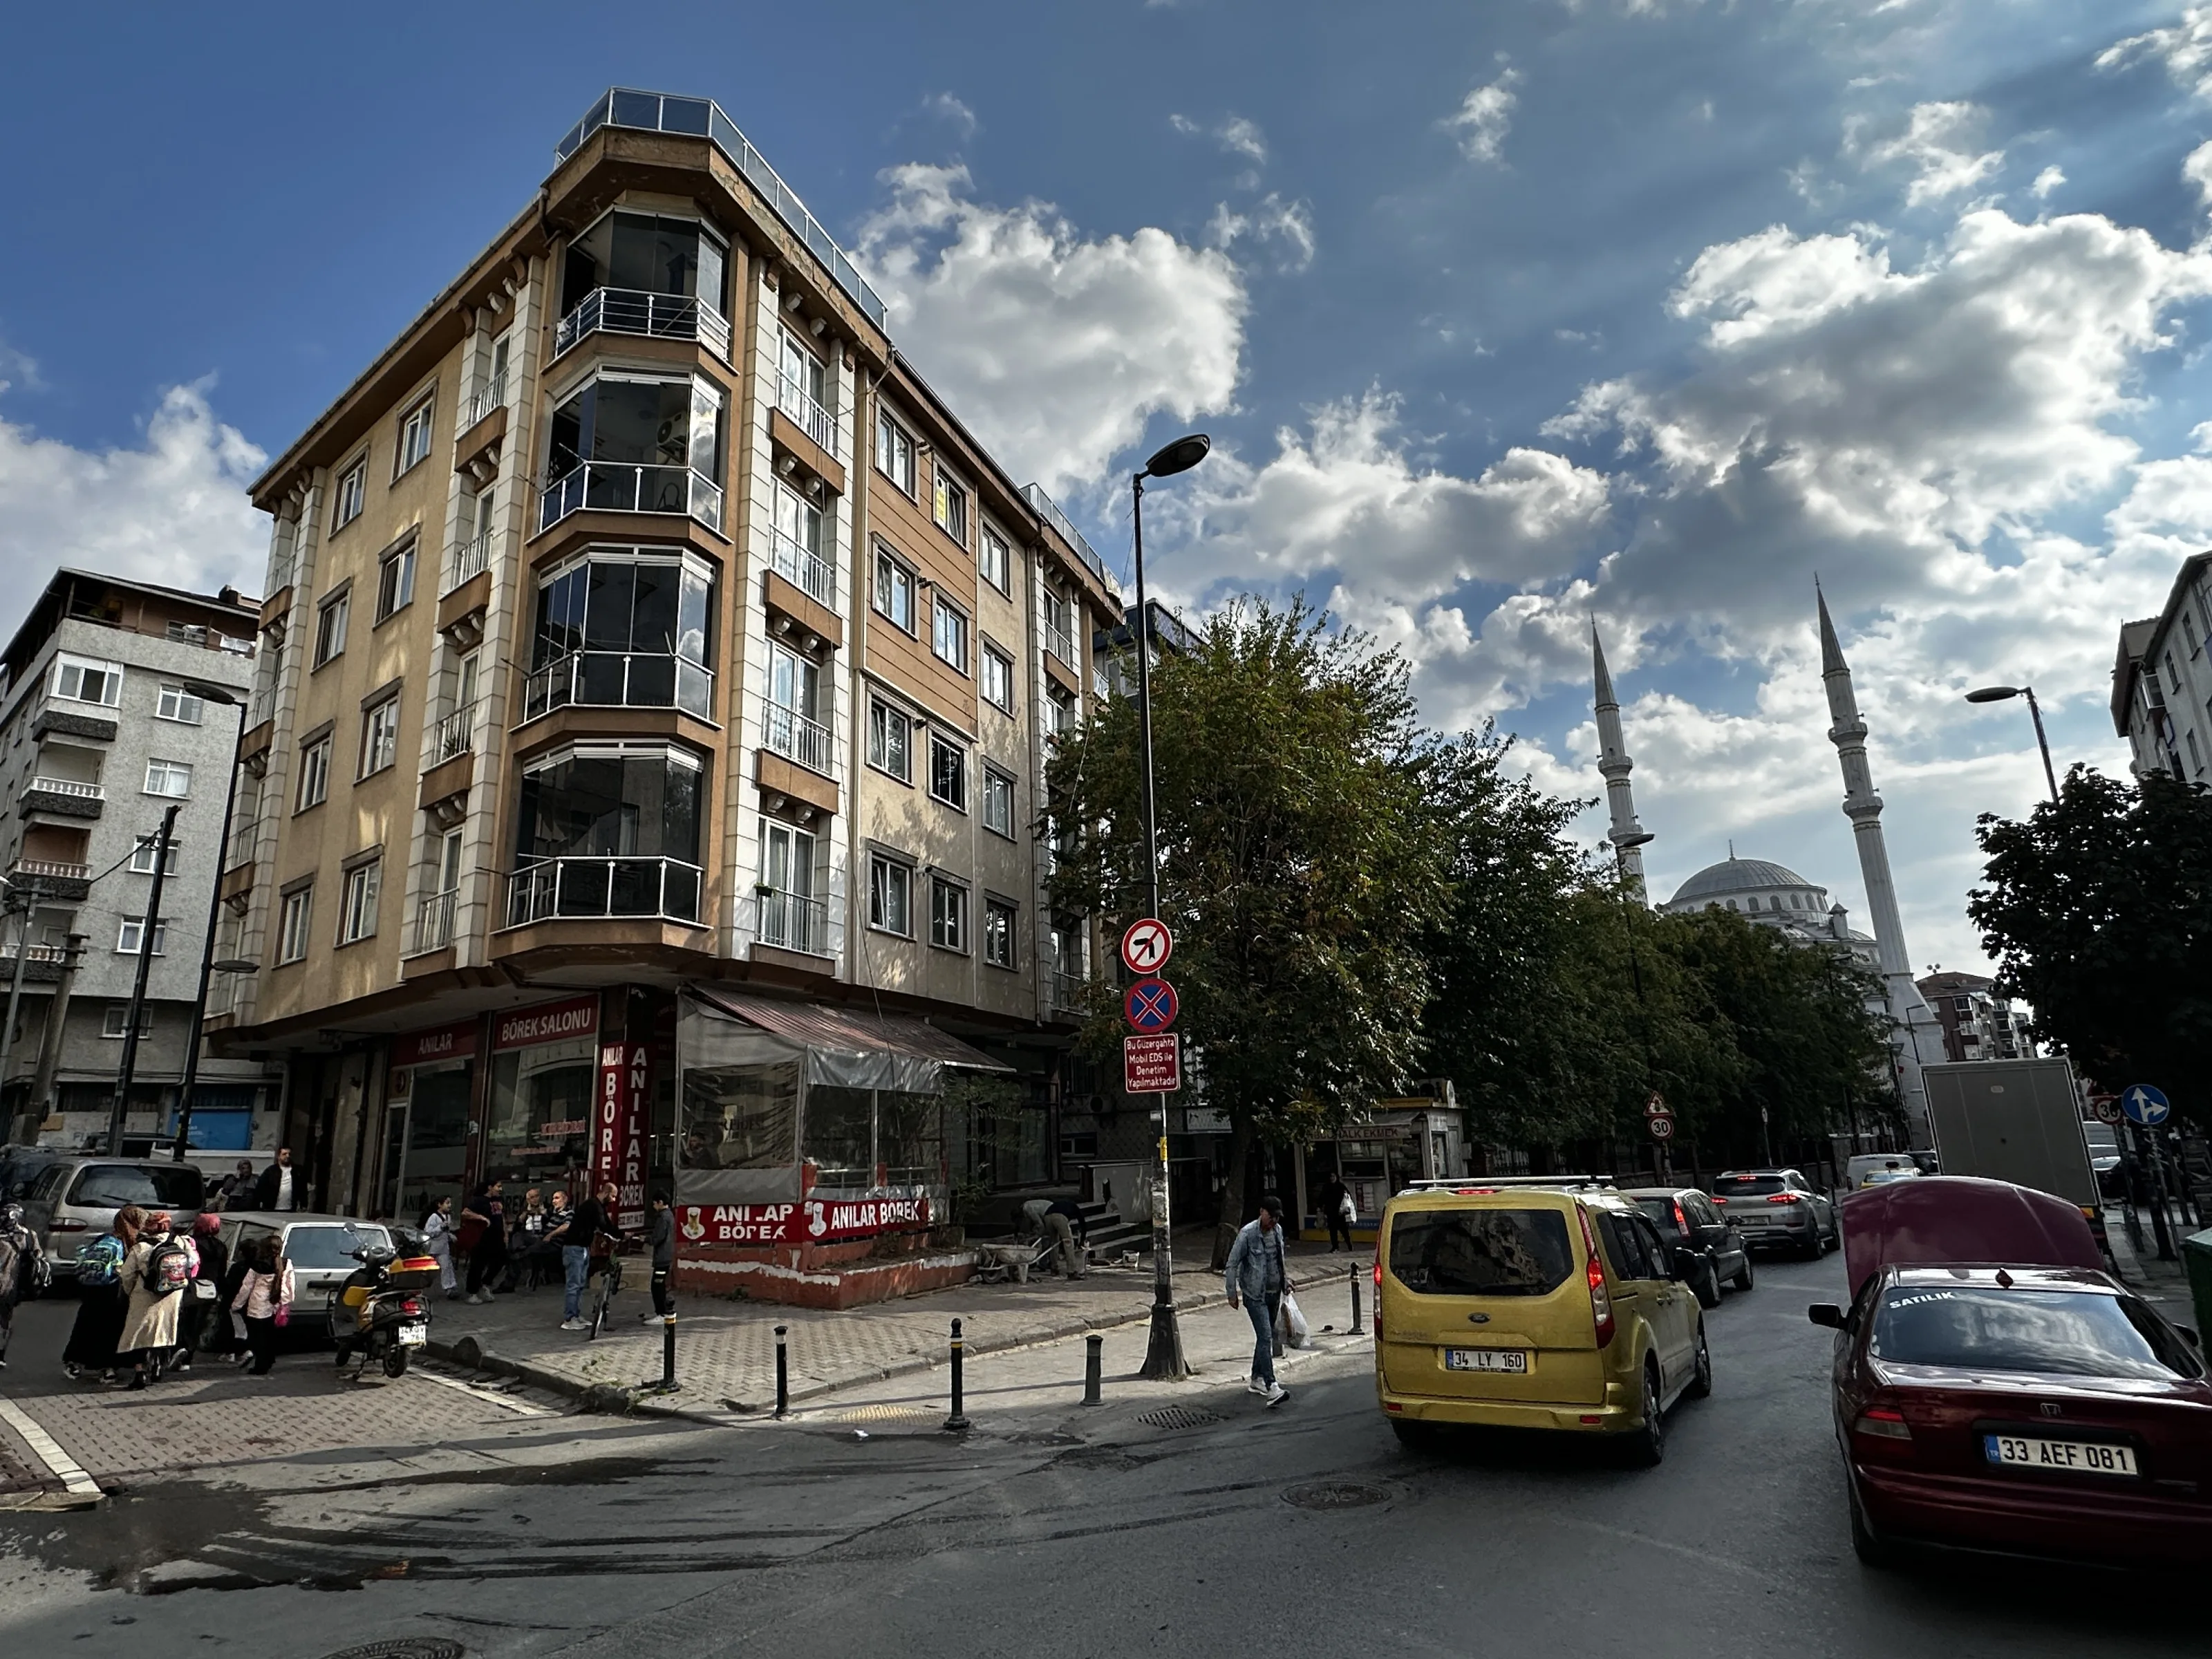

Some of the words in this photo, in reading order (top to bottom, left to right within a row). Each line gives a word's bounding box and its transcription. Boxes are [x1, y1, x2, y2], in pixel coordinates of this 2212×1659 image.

[502, 1017, 539, 1042] BÖREK
[540, 1007, 591, 1035] SALONU
[418, 1033, 452, 1055] ANILAR
[1127, 1040, 1136, 1050] Bu
[602, 1046, 624, 1067] ANILAR
[1129, 1053, 1148, 1064] Mobil
[1149, 1053, 1163, 1062] EDS
[1164, 1052, 1173, 1062] ile
[1136, 1065, 1167, 1076] Denetim
[626, 1047, 647, 1182] ANILAR
[1363, 1128, 1398, 1138] EKMEK
[1653, 1121, 1668, 1133] 30
[619, 1182, 644, 1207] BÖREK
[830, 1205, 877, 1230] ANILAR
[880, 1199, 919, 1224] BÖREK
[1889, 1291, 1956, 1309] SATILIK
[1455, 1352, 1468, 1365] 34
[1478, 1353, 1492, 1367] LY
[1502, 1354, 1522, 1367] 160
[2002, 1440, 2029, 1461] 33
[2041, 1443, 2077, 1465] AEF
[2086, 1447, 2127, 1470] 081
